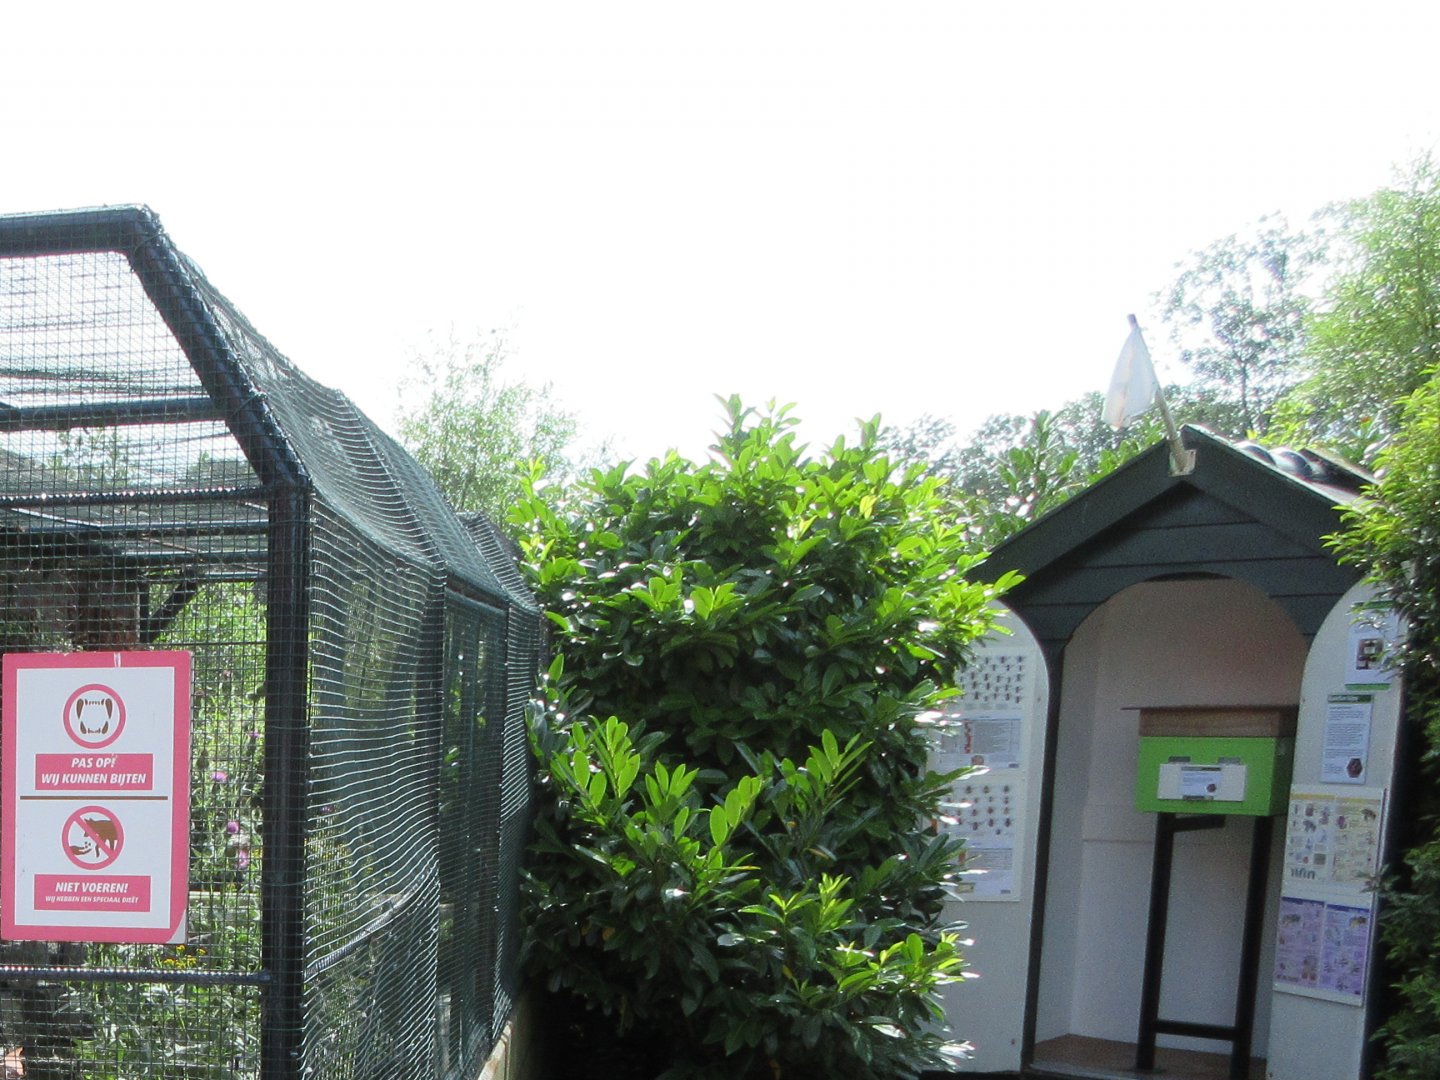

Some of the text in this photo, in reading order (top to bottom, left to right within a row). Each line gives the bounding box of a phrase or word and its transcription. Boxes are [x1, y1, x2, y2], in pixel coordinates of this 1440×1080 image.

[71, 757, 117, 768] PAS OP!
[41, 773, 146, 786] WIJ KUNNEN BIJTEN
[55, 882, 129, 893] NIET VOEREN!
[45, 895, 55, 903] WIJ
